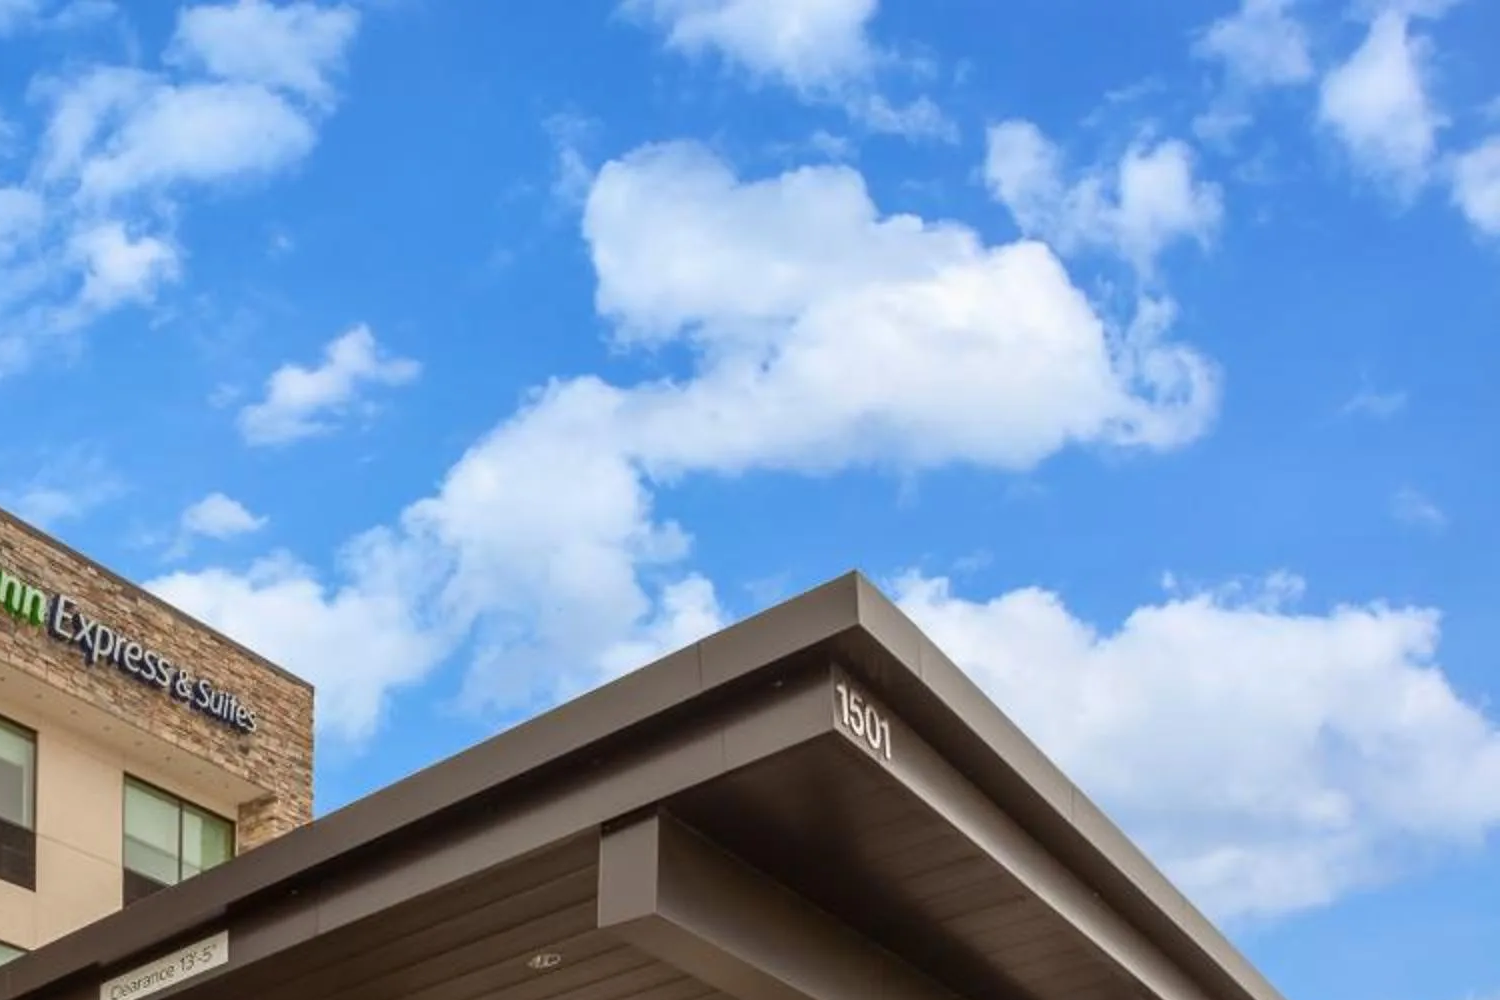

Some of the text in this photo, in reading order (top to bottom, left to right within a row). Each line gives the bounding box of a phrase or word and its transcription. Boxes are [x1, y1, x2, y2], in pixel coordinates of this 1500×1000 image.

[53, 593, 172, 687] Express
[175, 669, 195, 699] &
[195, 679, 257, 732] Suites
[836, 684, 891, 760] 1501
[110, 964, 175, 1000] Clearance
